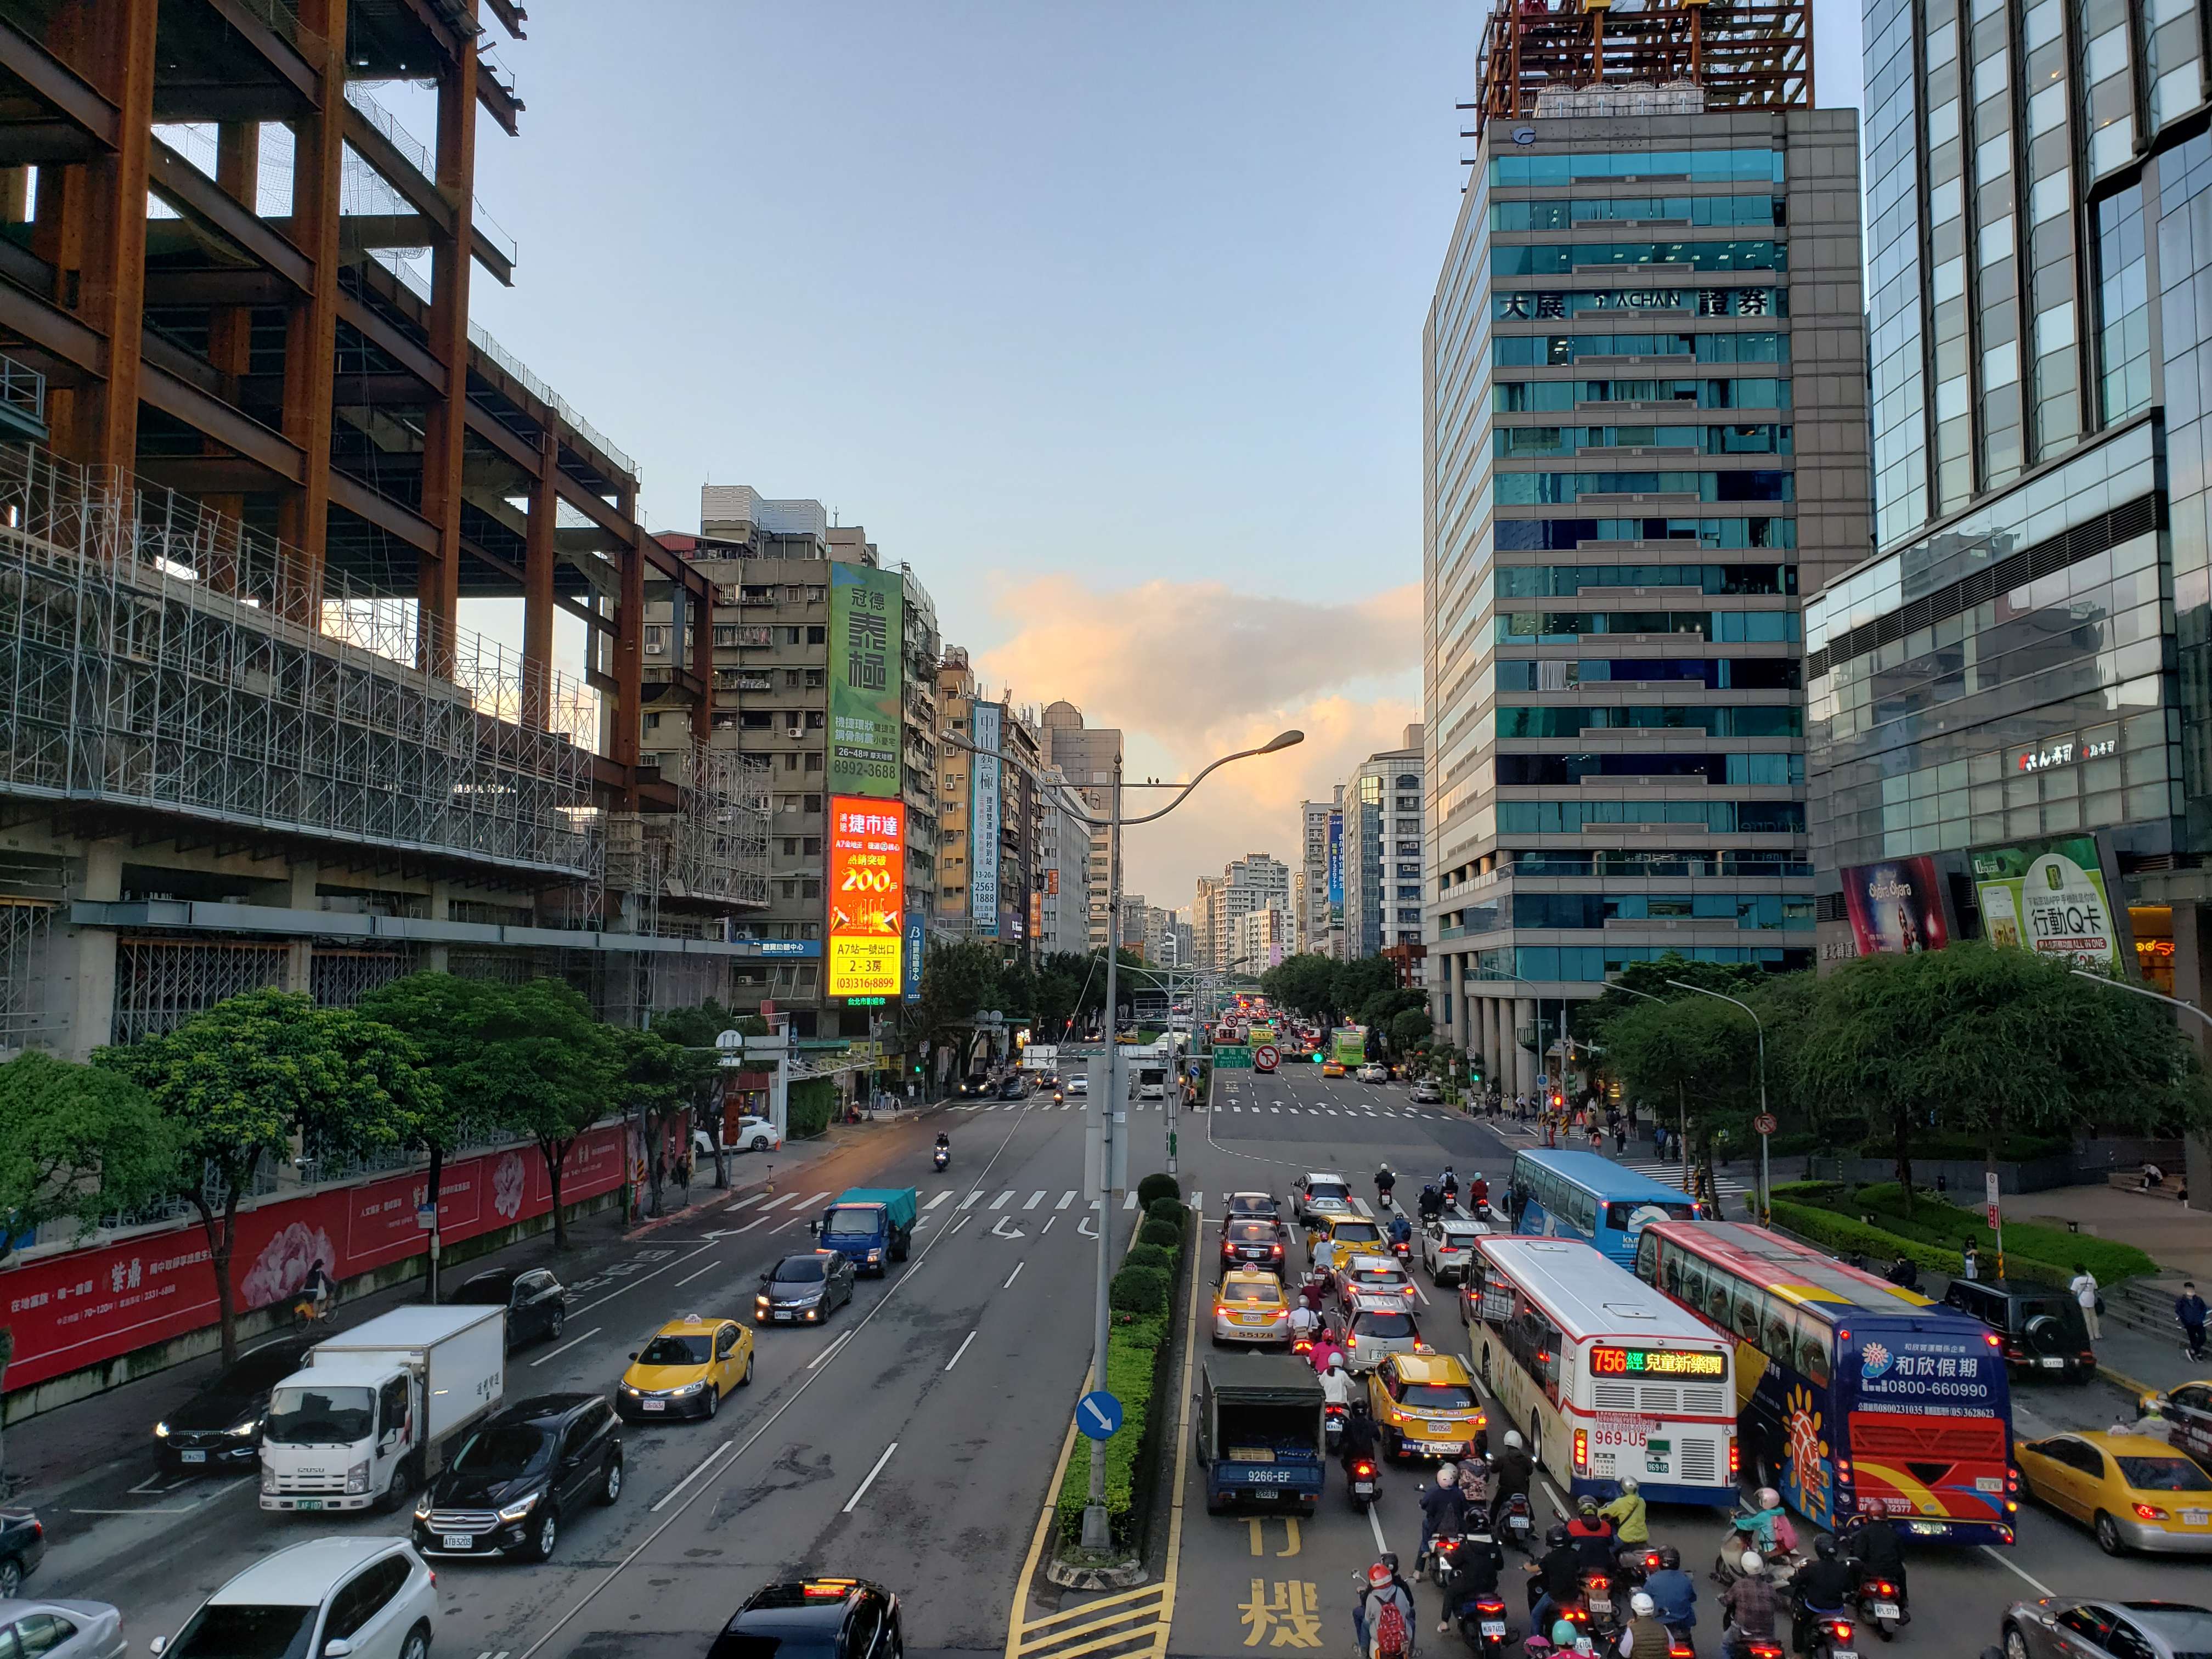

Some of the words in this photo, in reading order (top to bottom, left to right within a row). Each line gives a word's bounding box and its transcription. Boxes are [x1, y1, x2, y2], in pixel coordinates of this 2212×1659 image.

[1500, 291, 1566, 319] 大展
[1699, 289, 1768, 315] 證券
[851, 587, 885, 611] 冠德
[834, 759, 895, 779] 8992-3688
[849, 814, 898, 836] 捷市達
[975, 882, 994, 891] 2563
[975, 893, 994, 903] 1888
[2032, 905, 2101, 936] 行動Q卡
[837, 944, 894, 955] A7站一號出口
[1593, 1349, 1627, 1372] 756
[1627, 1352, 1644, 1371] 經
[1645, 1353, 1723, 1374] 兒童新樂園
[1895, 1356, 1978, 1379] 和欣假期
[1888, 1380, 1988, 1398] 0800-660990
[1595, 1430, 1647, 1448] 969-U5
[1248, 1471, 1291, 1482] 9266-EF
